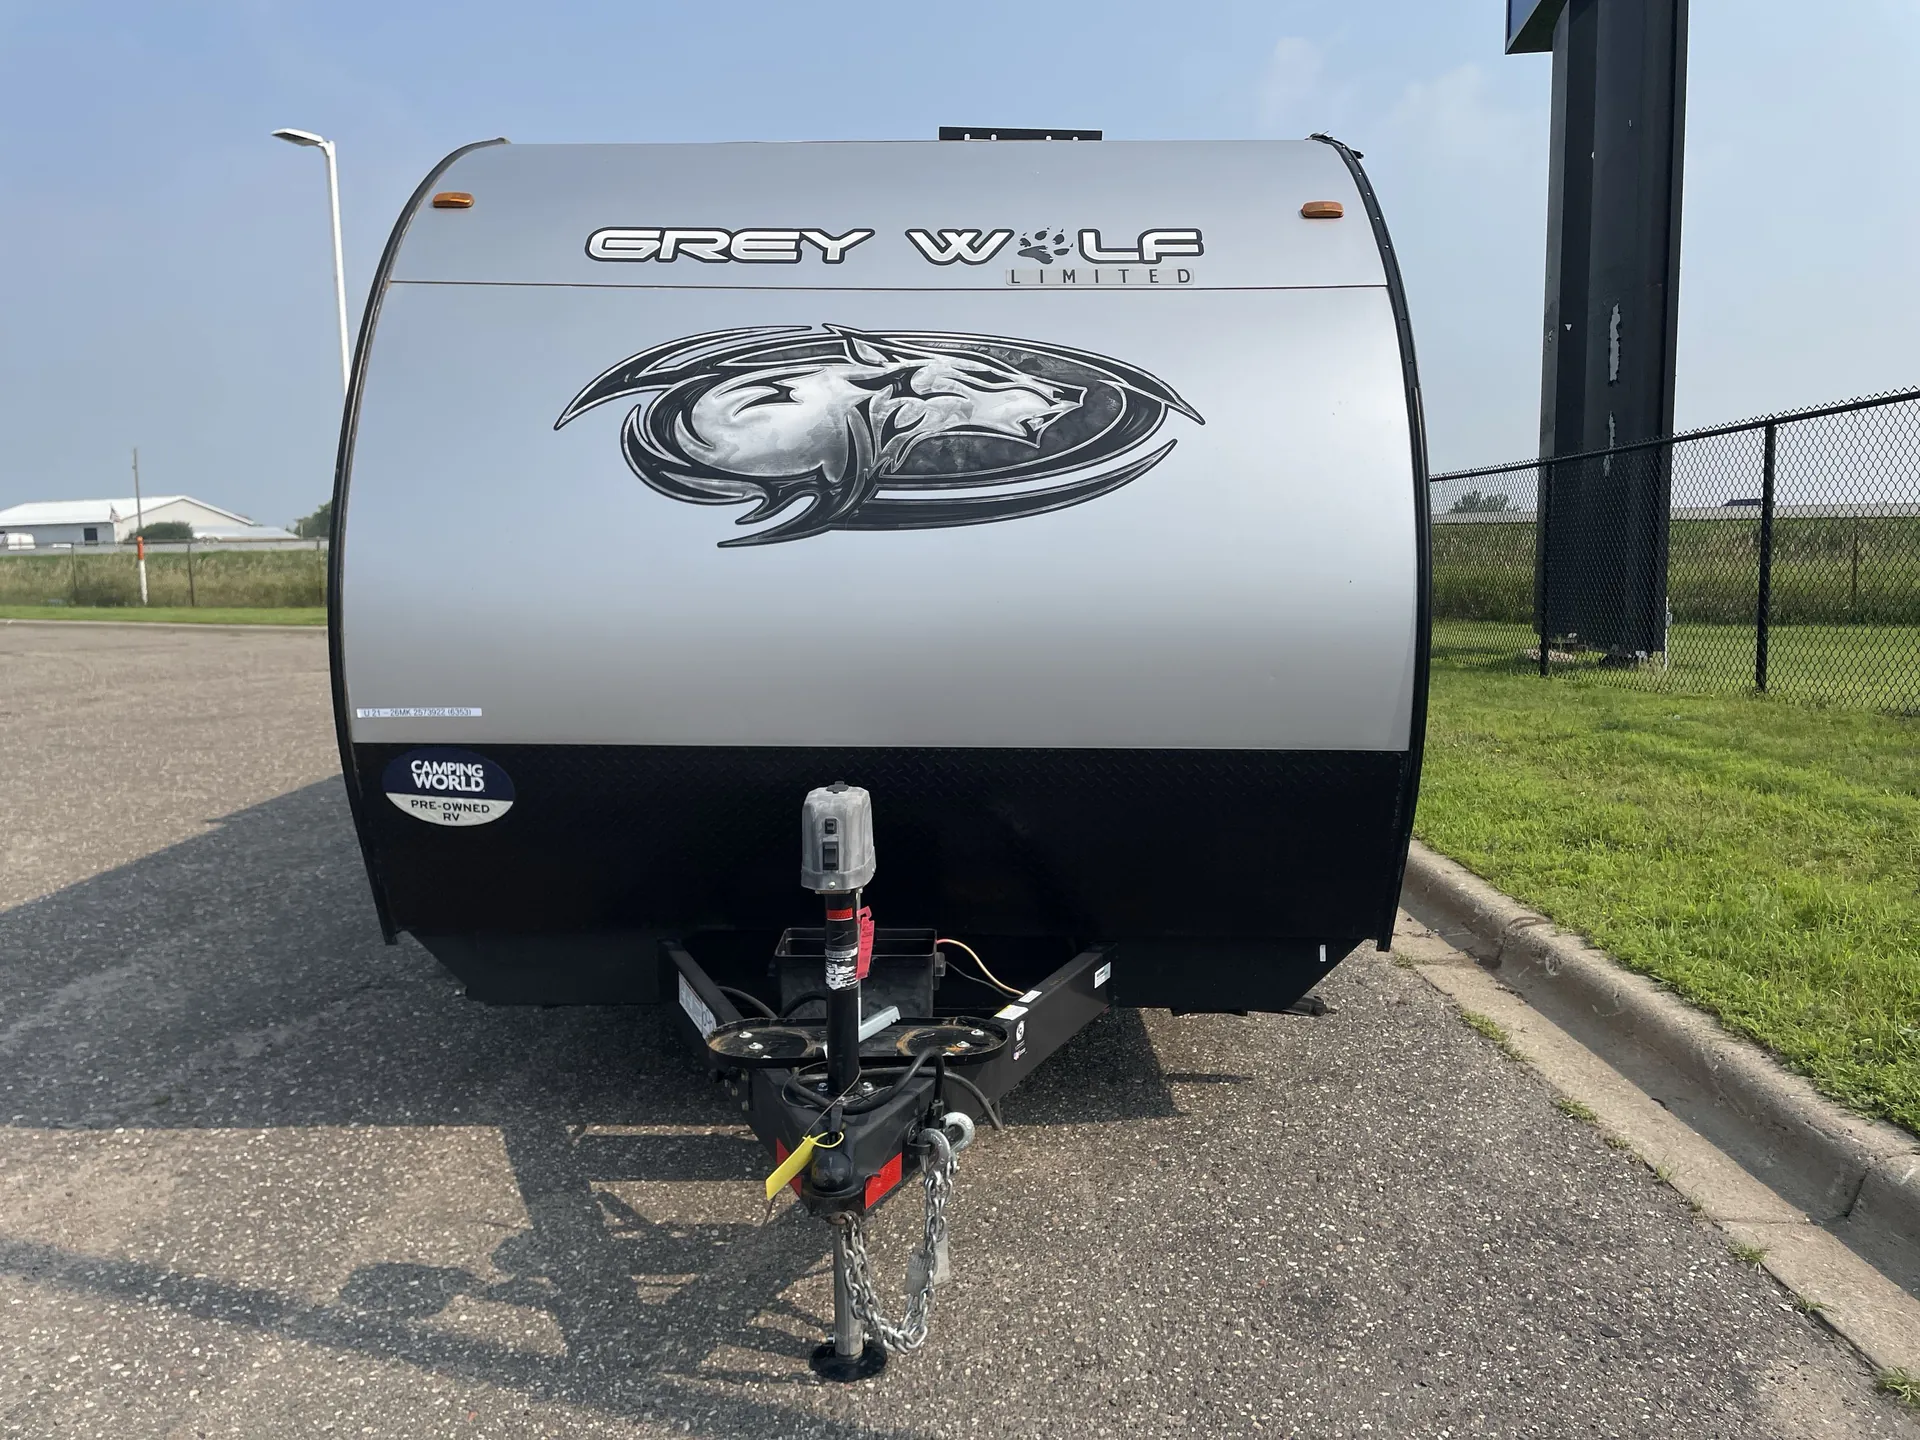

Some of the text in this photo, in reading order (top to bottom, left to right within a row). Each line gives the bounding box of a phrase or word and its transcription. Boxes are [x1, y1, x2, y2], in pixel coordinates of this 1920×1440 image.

[586, 226, 875, 264] GREY
[1010, 269, 1192, 285] LIMITED
[372, 709, 380, 717] 21
[411, 760, 483, 778] CAMPING
[412, 773, 485, 792] WORLD
[411, 800, 490, 813] PRE-OWNED
[443, 812, 460, 821] RV
